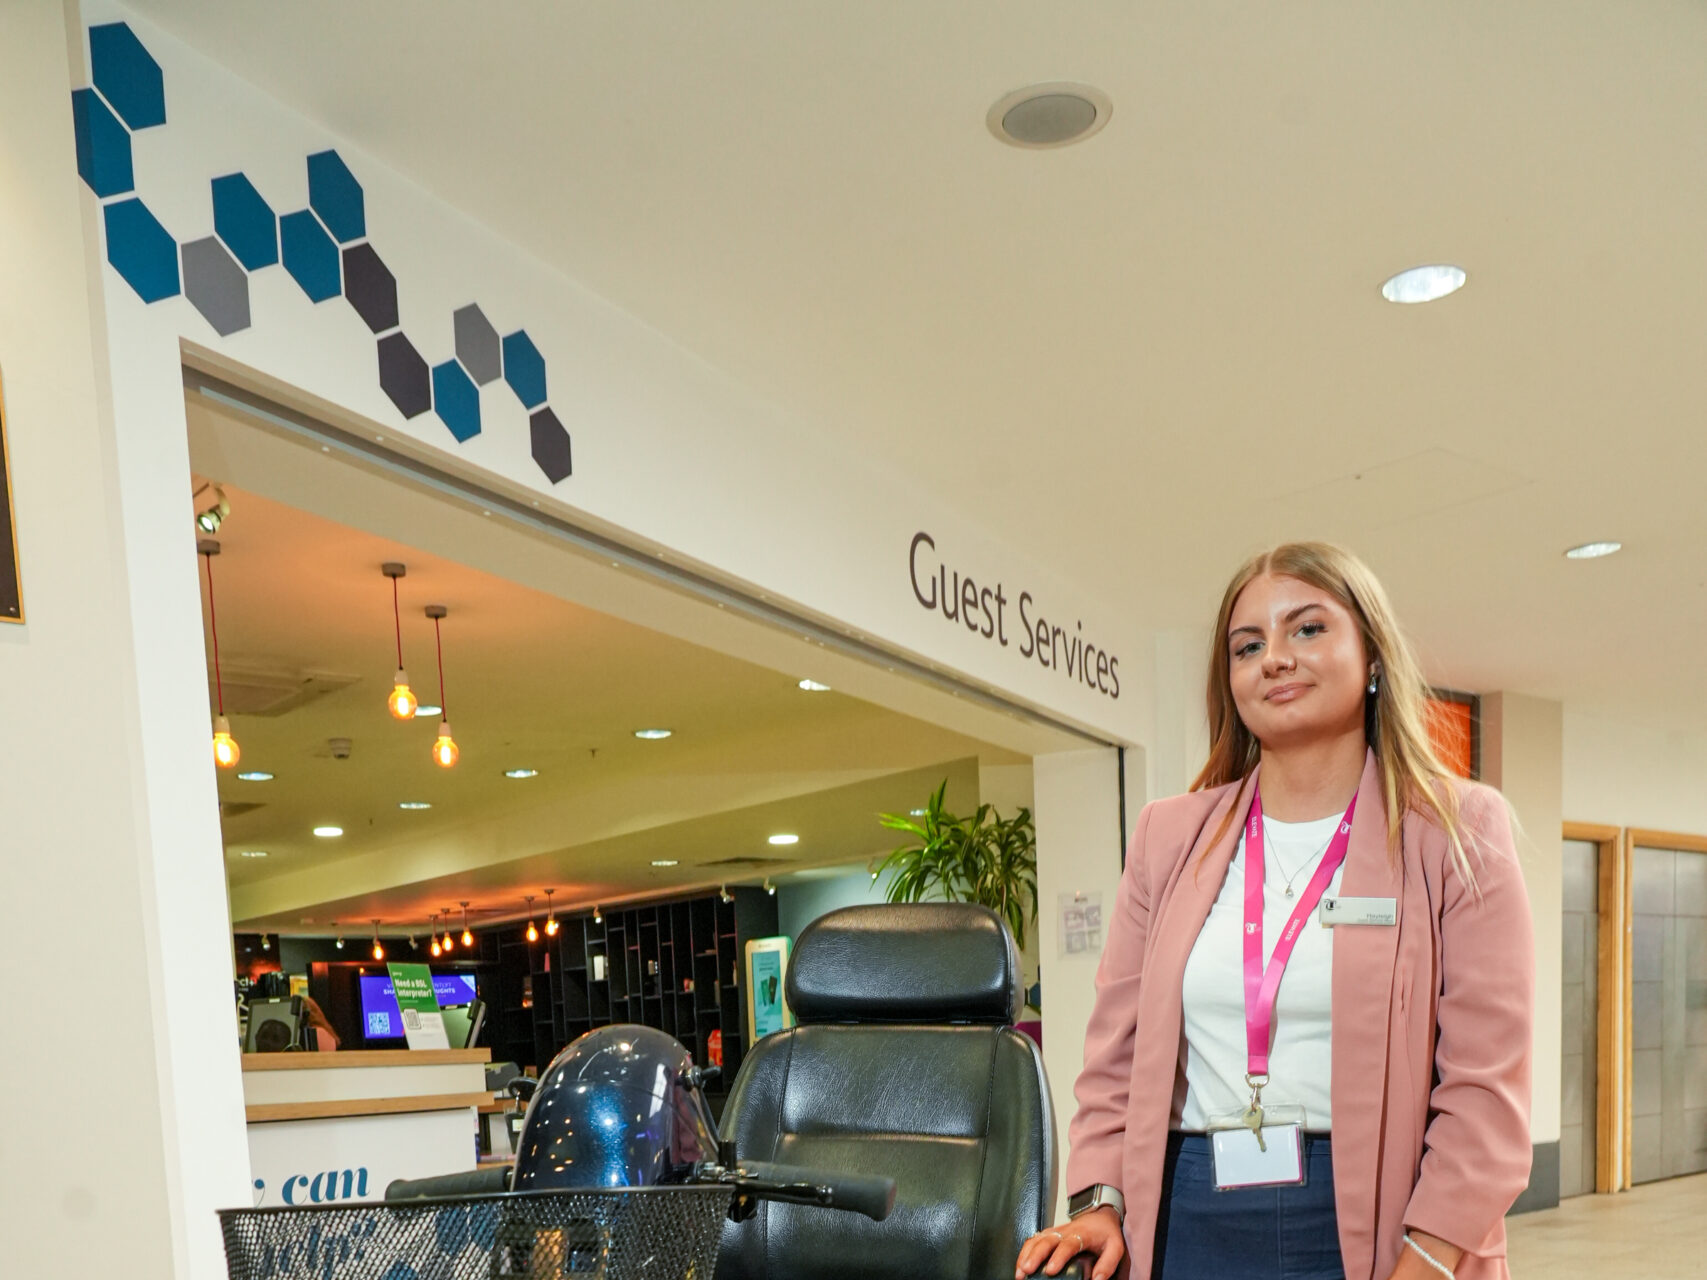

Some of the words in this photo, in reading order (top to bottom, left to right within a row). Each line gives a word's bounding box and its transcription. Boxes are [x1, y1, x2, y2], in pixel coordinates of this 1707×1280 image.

[909, 531, 1008, 647] Guest
[1019, 591, 1120, 699] Services
[282, 1167, 371, 1206] can
